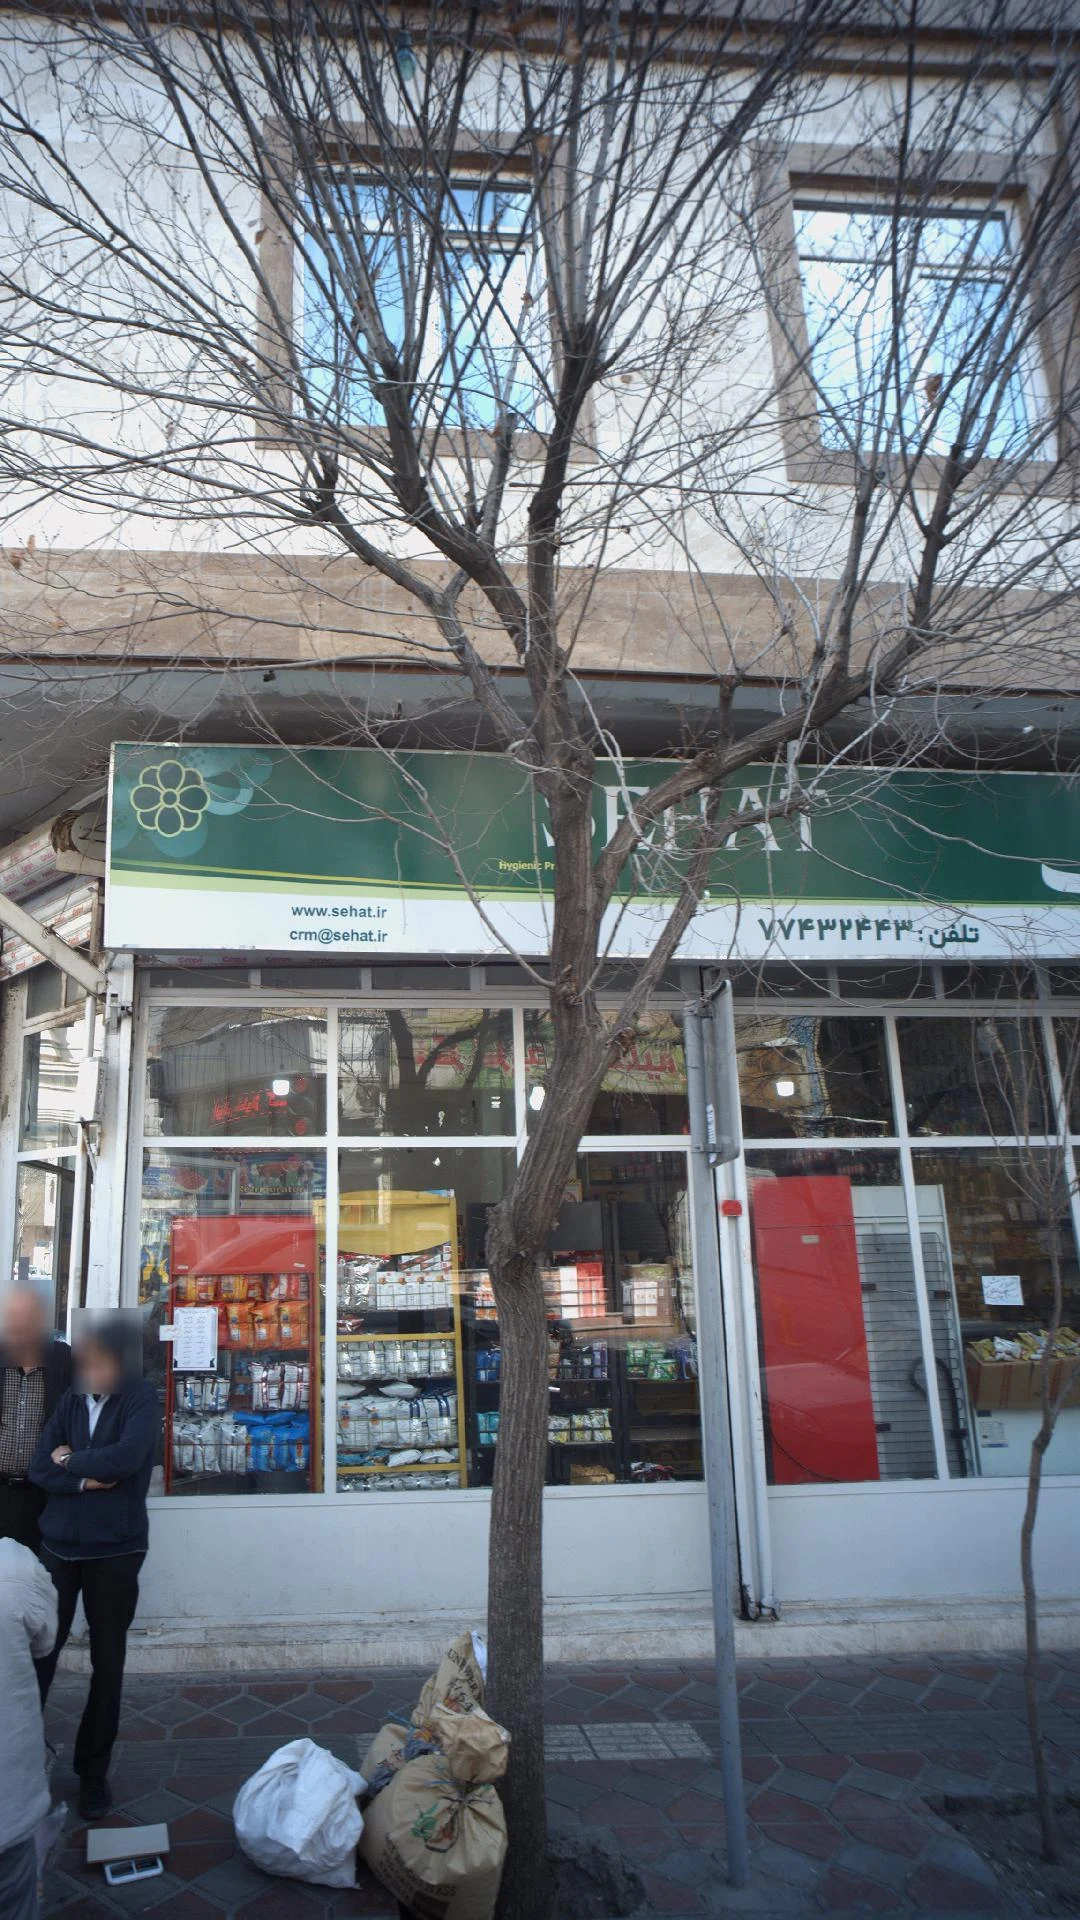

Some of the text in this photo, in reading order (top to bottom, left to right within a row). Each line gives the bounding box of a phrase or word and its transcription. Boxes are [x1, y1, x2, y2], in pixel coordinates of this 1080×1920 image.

[291, 905, 388, 919] www.sehat.ir
[289, 929, 389, 945] crm@sehat.ir
[757, 917, 913, 941] ۷۷۴۳۲۴۴۳
